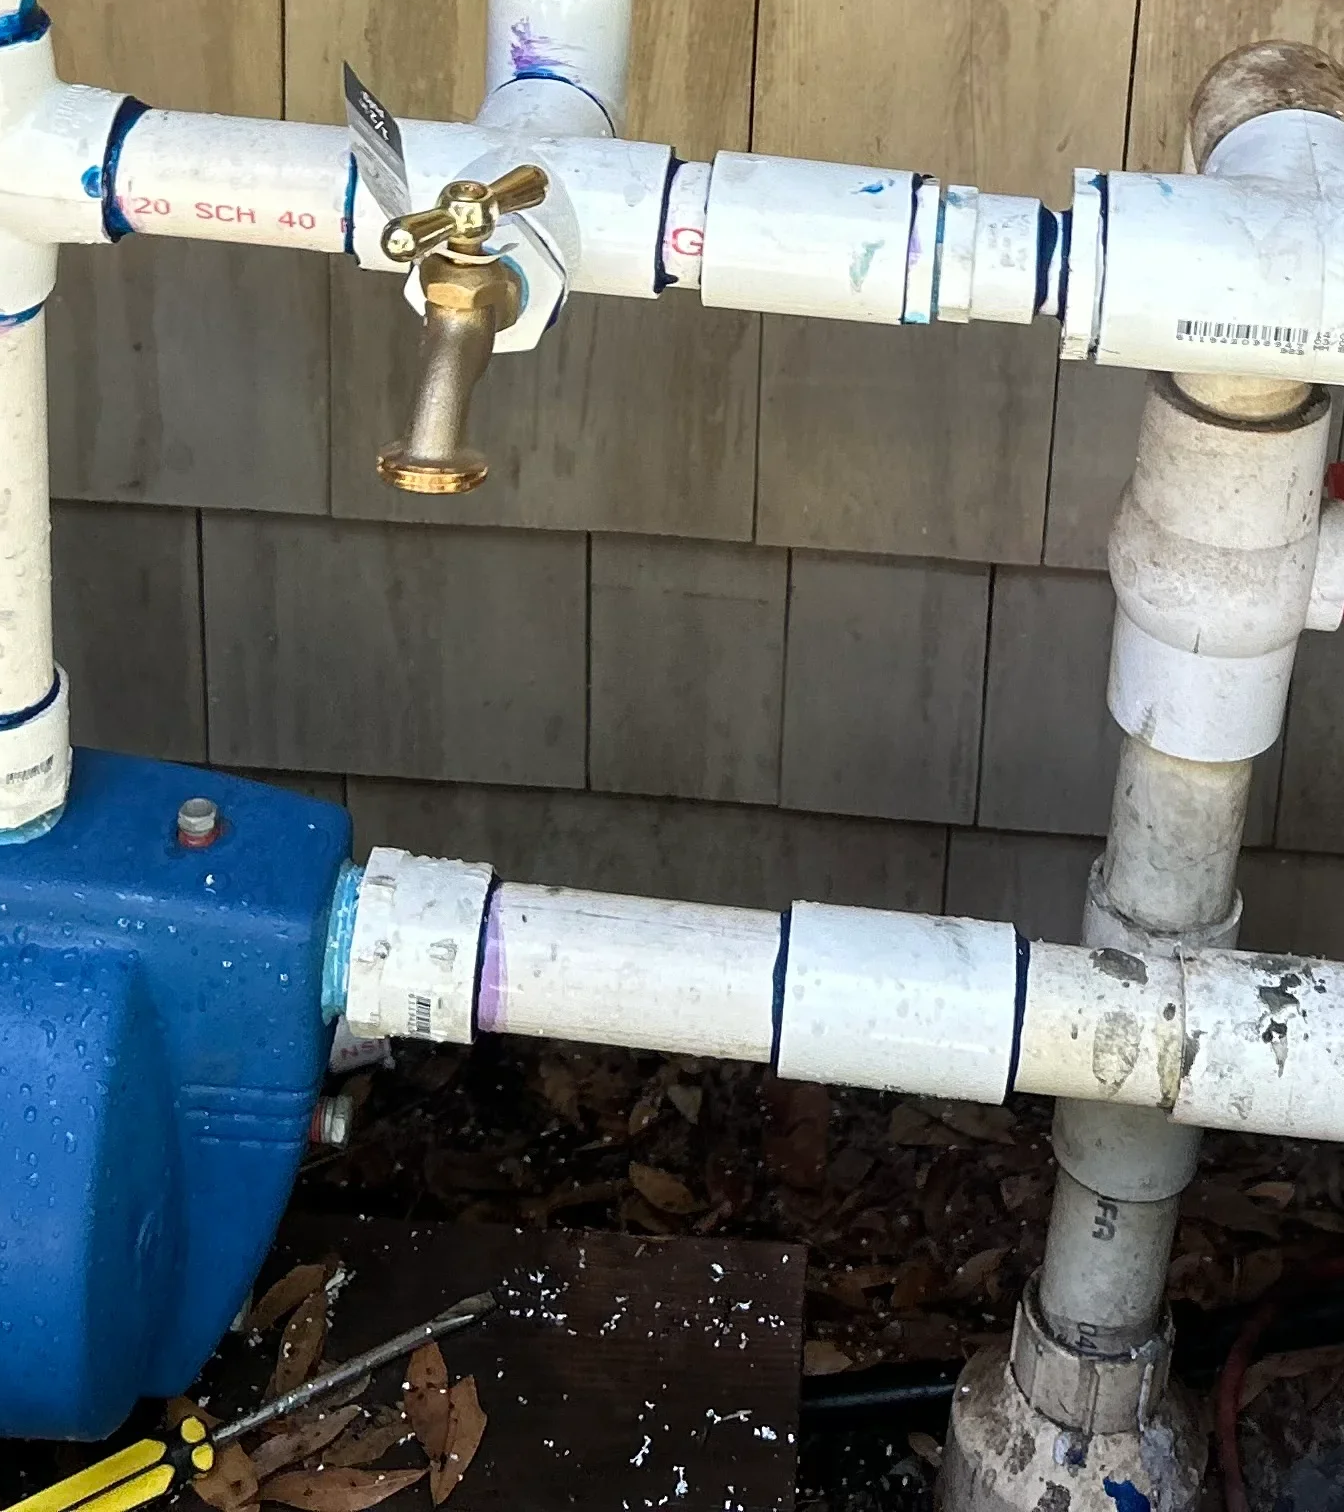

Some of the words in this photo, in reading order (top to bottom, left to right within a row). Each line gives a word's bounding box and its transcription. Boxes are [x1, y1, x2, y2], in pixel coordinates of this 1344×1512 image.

[194, 201, 257, 224] SCH
[277, 210, 317, 230] 40
[670, 226, 704, 257] G
